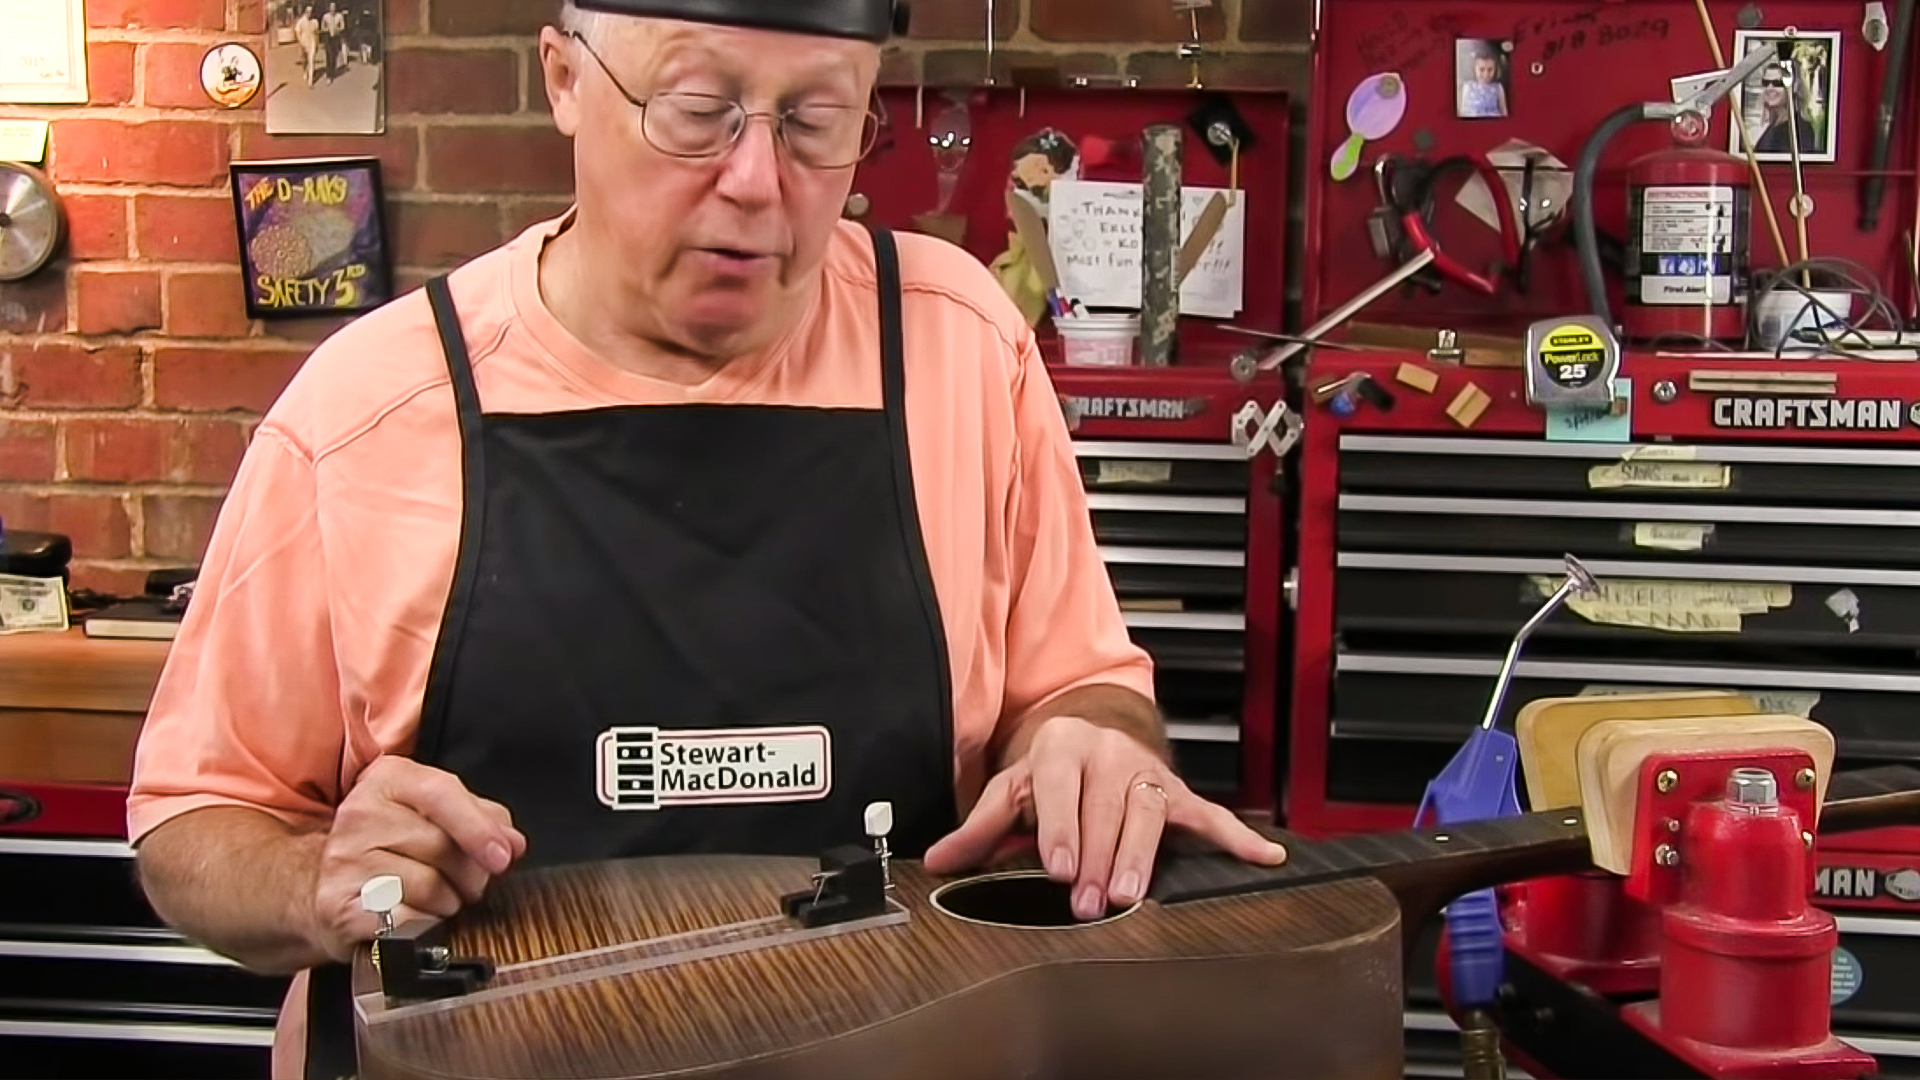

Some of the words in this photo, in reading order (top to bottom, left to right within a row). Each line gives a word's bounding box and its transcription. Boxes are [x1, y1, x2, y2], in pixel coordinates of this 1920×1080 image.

[245, 177, 274, 211] THE
[256, 274, 330, 308] SAFETY
[1714, 397, 1901, 428] CRAFTSMAN
[660, 742, 776, 766] Stewart-
[660, 762, 816, 791] MacDonald
